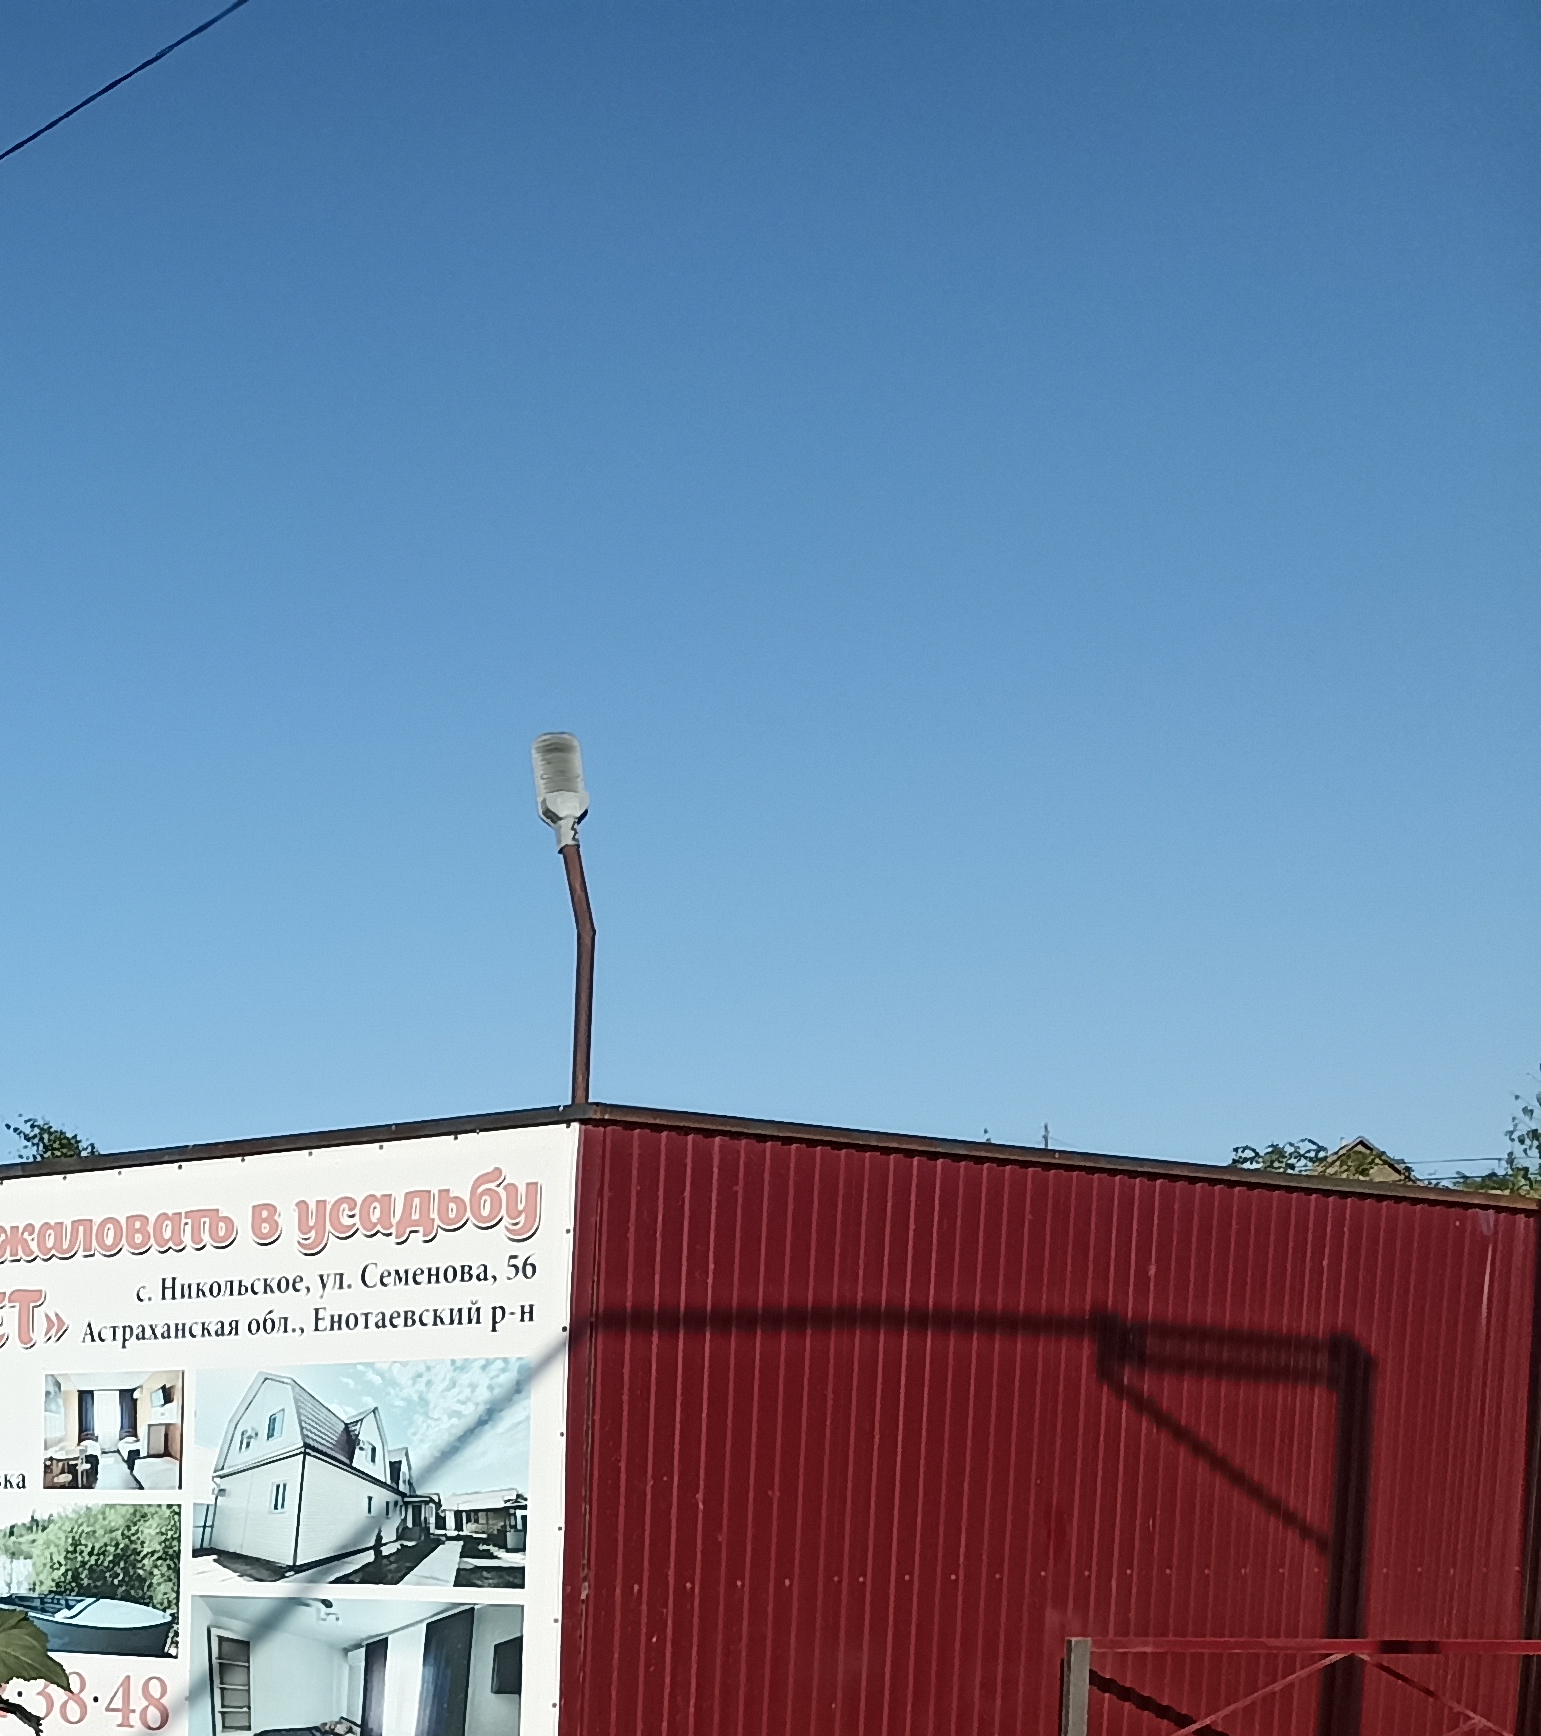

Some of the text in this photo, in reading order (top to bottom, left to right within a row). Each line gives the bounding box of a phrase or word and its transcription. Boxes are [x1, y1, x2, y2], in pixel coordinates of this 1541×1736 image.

[251, 1203, 282, 1246] в
[295, 1167, 542, 1256] усадьбу
[136, 1253, 538, 1302] с. Никольское, ул. Семенова, 56
[81, 1299, 536, 1349] Астраханская обл., Енотаевский р-н
